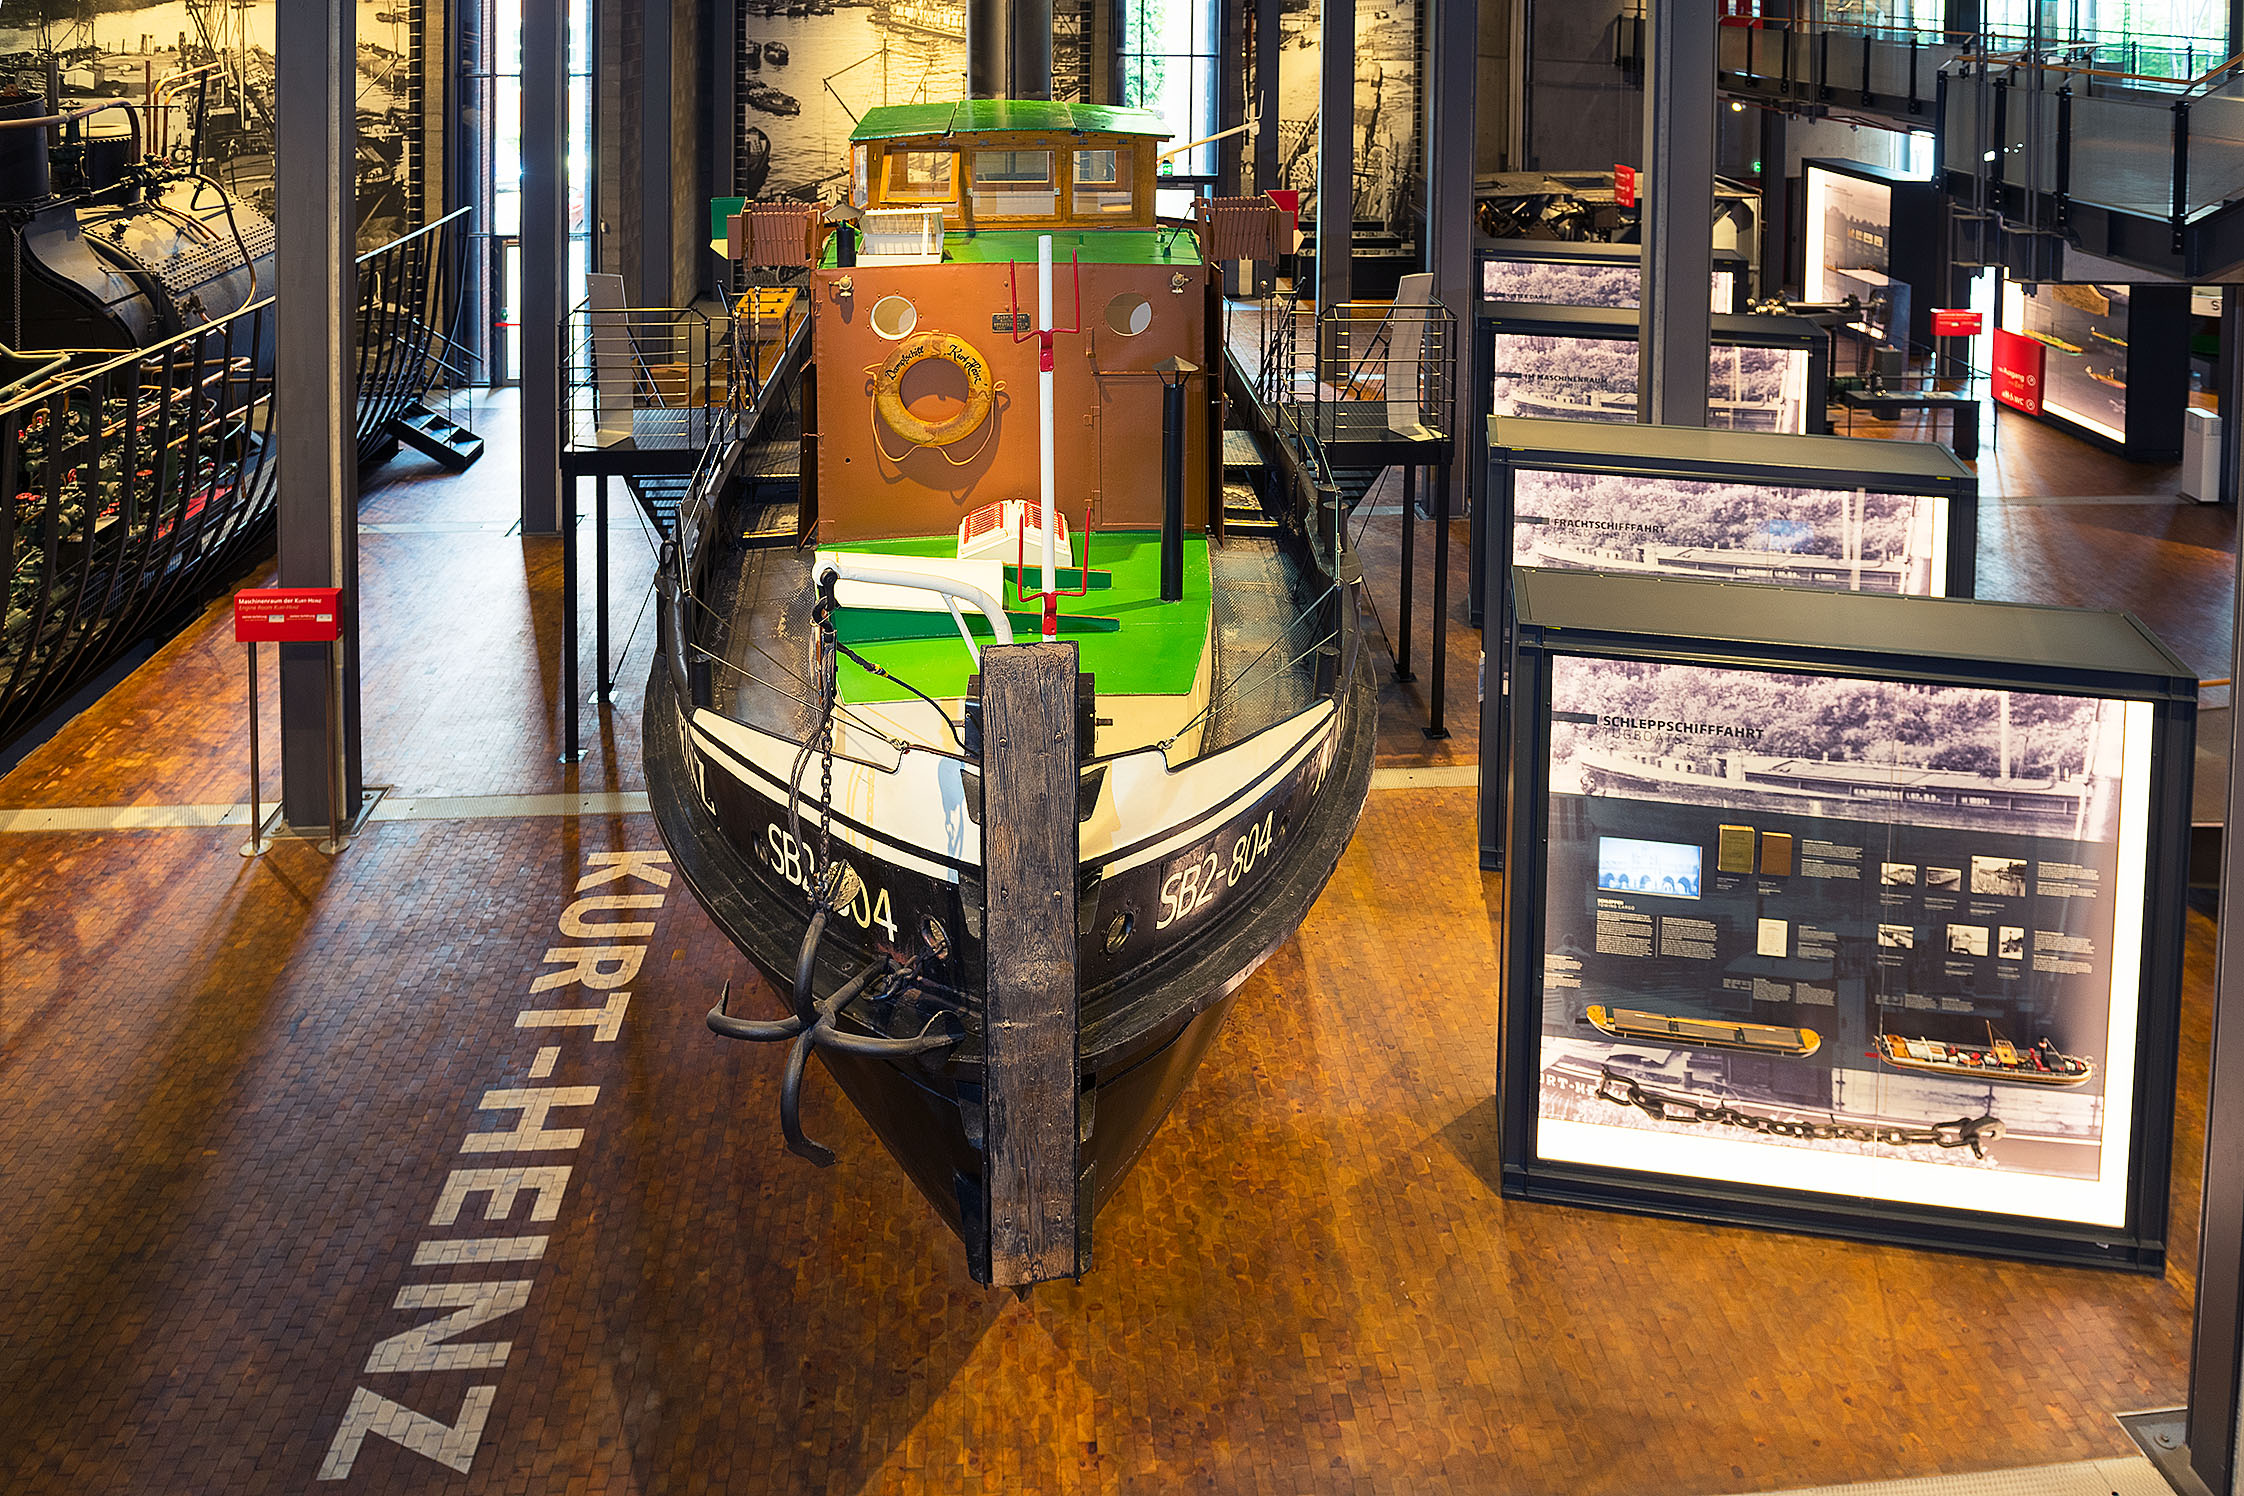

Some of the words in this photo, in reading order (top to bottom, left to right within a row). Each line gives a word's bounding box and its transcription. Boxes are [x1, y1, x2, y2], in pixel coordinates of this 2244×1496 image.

[1536, 373, 1608, 384] MASCHINENRAUM
[1554, 518, 1666, 534] FRACHTSCHIFFFAHRT
[1602, 727, 1682, 744] TUGBOATS
[1603, 715, 1764, 740] SCHLEPPSCHIFFFAHRT
[1155, 810, 1274, 930] SB2-804
[316, 850, 672, 1481] KURT-HEINZ
